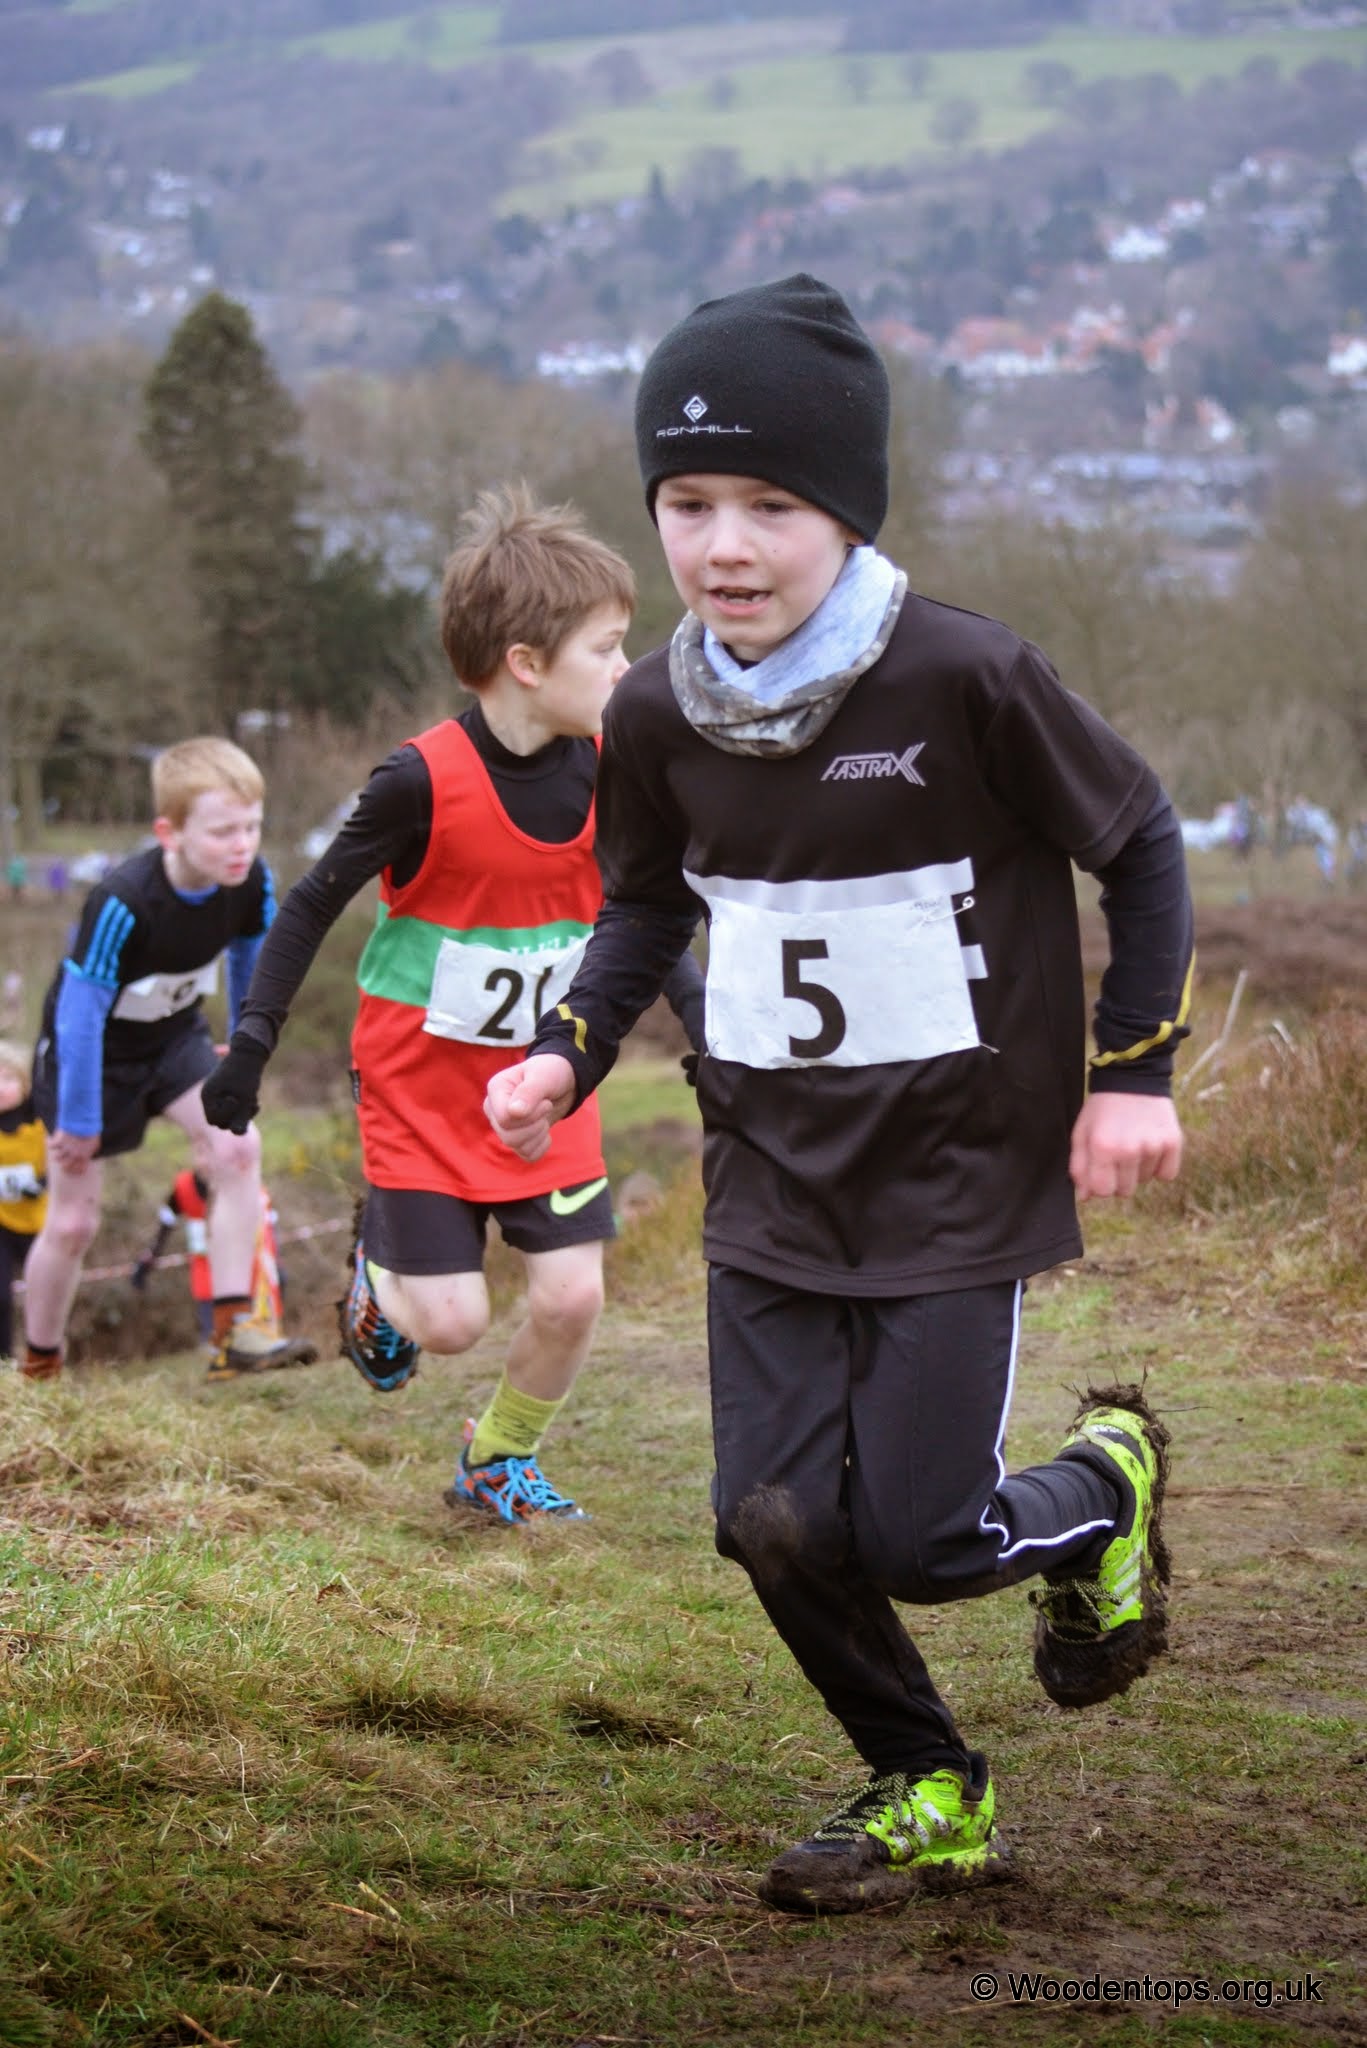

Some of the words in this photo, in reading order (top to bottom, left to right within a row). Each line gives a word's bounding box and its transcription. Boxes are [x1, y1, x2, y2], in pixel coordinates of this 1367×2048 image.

[656, 424, 752, 438] RONHILL
[820, 741, 926, 787] FASTRAX
[781, 938, 847, 1059] 5
